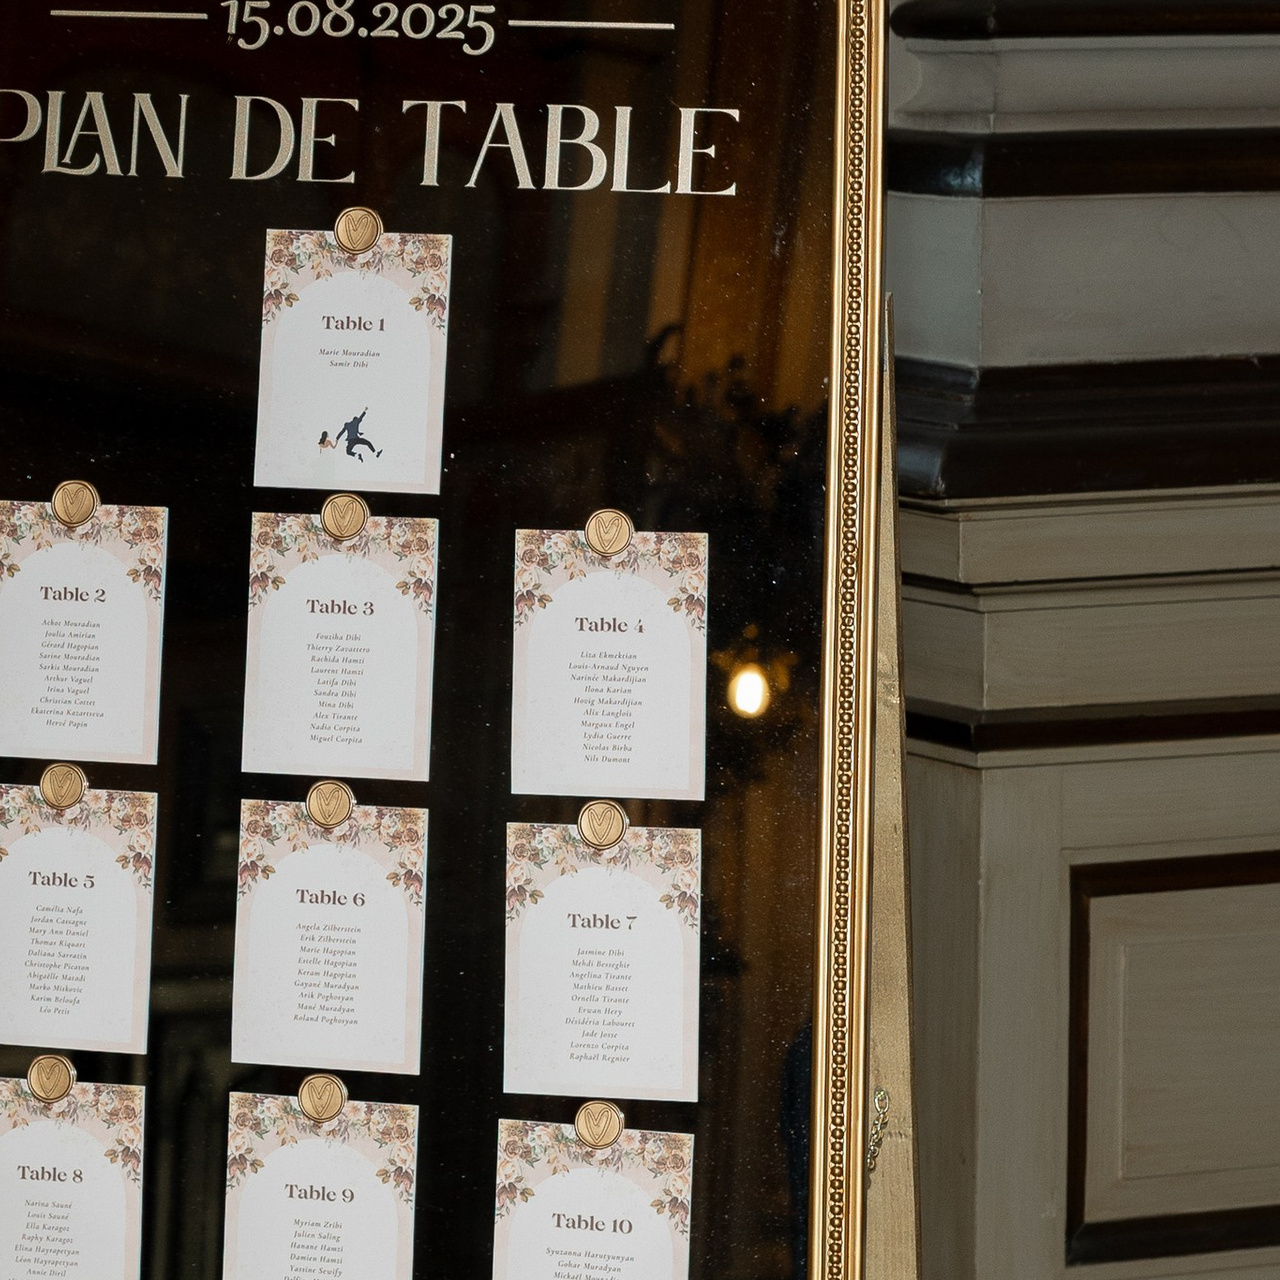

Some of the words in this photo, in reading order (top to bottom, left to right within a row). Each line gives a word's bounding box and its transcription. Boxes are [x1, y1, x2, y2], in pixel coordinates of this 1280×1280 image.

[229, 95, 360, 184] DE
[402, 100, 740, 196] TABLE
[321, 315, 373, 332] Table
[379, 318, 385, 332] 1
[319, 348, 340, 356] Marie
[341, 349, 380, 357] Mouradian
[329, 360, 351, 368] Samir
[40, 586, 90, 602] Table
[93, 588, 106, 603] 2
[306, 599, 358, 616] Table
[362, 601, 375, 616] 3
[574, 617, 628, 633] Table
[634, 619, 646, 634] 4
[67, 642, 99, 652] Hagopian
[306, 644, 333, 654] Thierry
[39, 663, 60, 671] Sarkis
[62, 664, 99, 673] Mouradian
[310, 666, 338, 674] Laurent
[568, 662, 620, 671] Louis-Arnaud
[621, 664, 649, 674] Nguyen
[43, 674, 68, 682] Arthur
[314, 689, 339, 697] Sandra
[341, 690, 357, 698] Dibi
[583, 732, 604, 741] Lydia
[584, 754, 599, 762] Nils
[601, 755, 630, 763] Dumont
[28, 871, 78, 888] Table
[83, 874, 95, 889] 5
[295, 889, 348, 906] Table
[352, 892, 366, 907] 6
[567, 913, 621, 930] Table
[626, 915, 638, 931] 7
[30, 938, 57, 946] Thomas
[300, 934, 316, 942] Erik
[317, 935, 357, 944] Zilberstein
[323, 970, 357, 980] Hagopian
[572, 983, 603, 991] Mathieu
[605, 984, 628, 992] Basset
[54, 996, 80, 1006] Beloufa
[571, 994, 600, 1002] Ornella
[602, 996, 630, 1004] Tirante
[578, 1006, 602, 1014] Erwan
[293, 1014, 319, 1022] Roland
[321, 1016, 358, 1026] Poghosyan
[570, 1041, 599, 1049] Lorenzo
[17, 1165, 68, 1183] Table
[72, 1169, 84, 1184] 8
[284, 1184, 337, 1202] Table
[341, 1188, 355, 1204] 9
[552, 1213, 606, 1232] Table
[612, 1219, 633, 1235] 10
[294, 1230, 316, 1238] Julien
[318, 1232, 341, 1243] Saling
[14, 1244, 33, 1252] Elina
[35, 1246, 80, 1256] Hayrapetyan
[557, 1260, 581, 1269] Gohar
[583, 1263, 622, 1274] Muradyan
